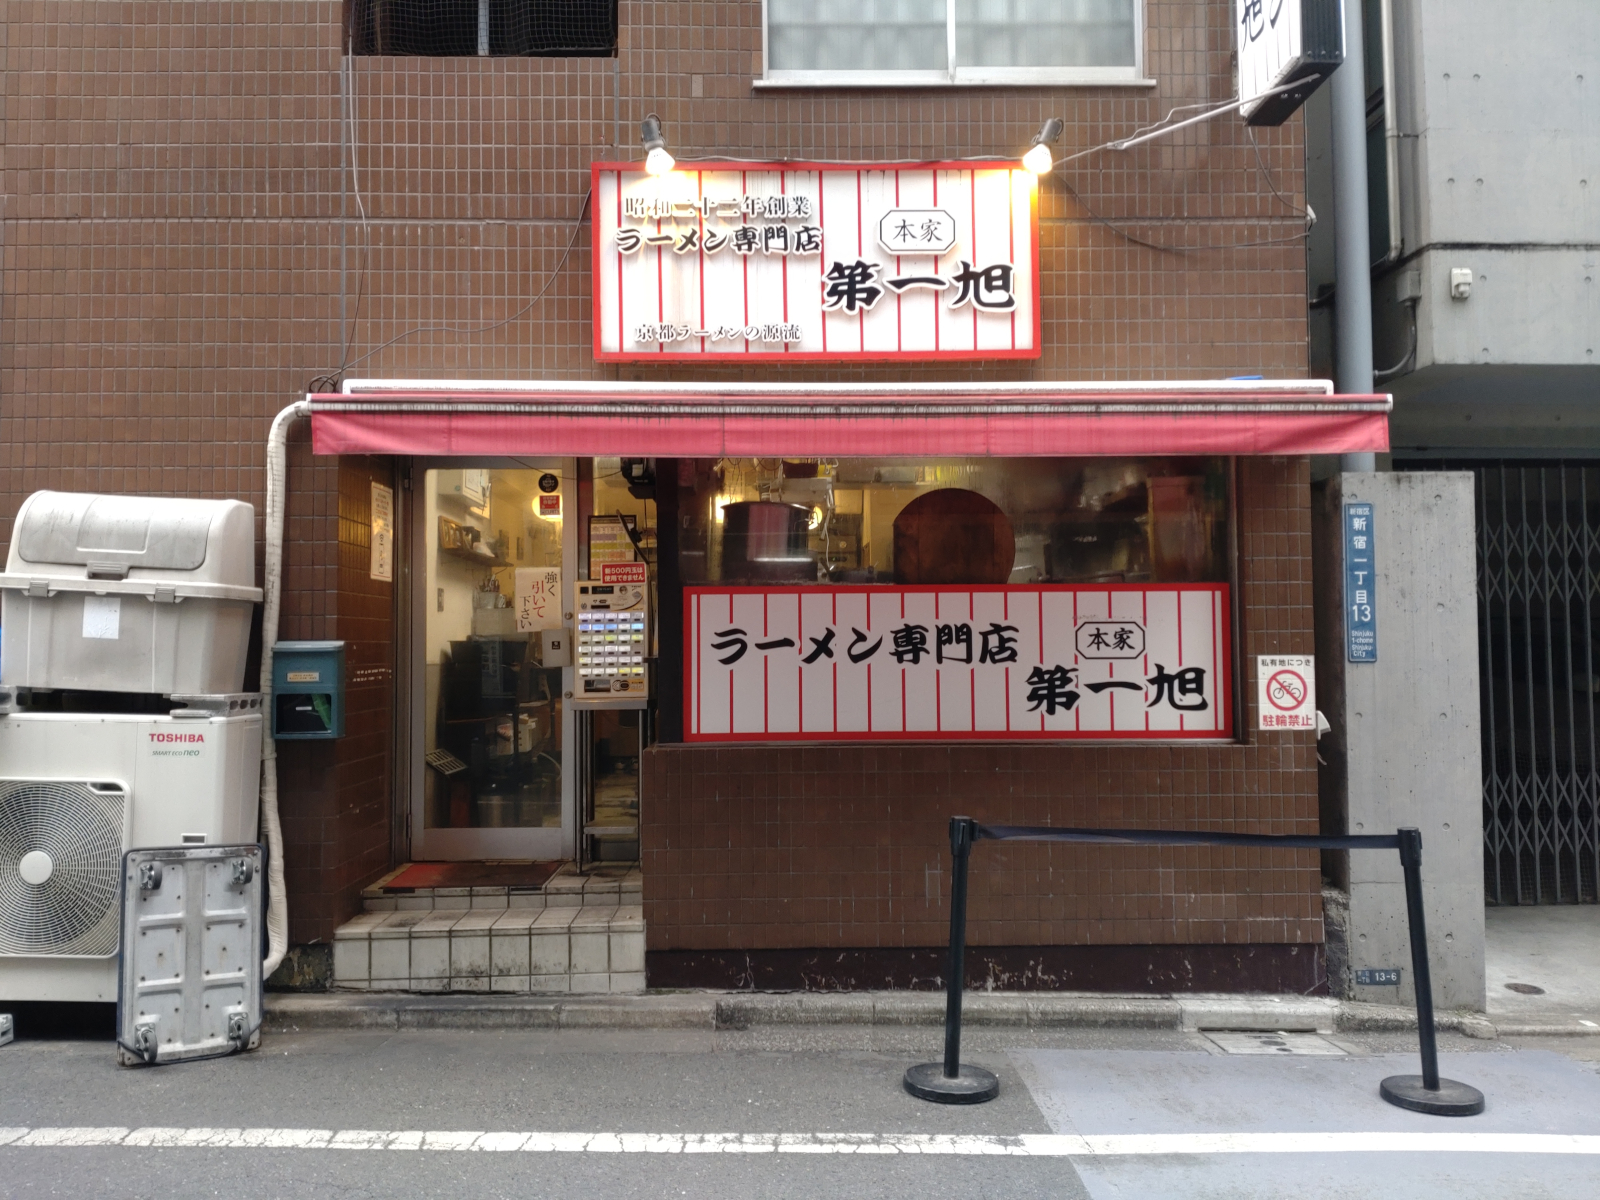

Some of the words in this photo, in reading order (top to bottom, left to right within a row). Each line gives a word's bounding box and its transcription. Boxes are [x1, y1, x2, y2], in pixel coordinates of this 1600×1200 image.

[625, 196, 812, 217] 昭和二十二年創業
[616, 225, 822, 254] ラーメン専門店
[893, 218, 944, 243] 本家
[825, 260, 1016, 312] 第一旭
[636, 323, 801, 341] 京都ラーメンの源流
[604, 567, 643, 575] 新500円玉は
[604, 574, 645, 582] 使用できません
[544, 571, 558, 597] 強く
[532, 580, 546, 618] 引いて
[519, 595, 532, 629] 下さい
[710, 623, 1019, 666] ラーメン専門店
[1086, 626, 1136, 652] 本家
[1261, 658, 1312, 667] 私有地につき
[1025, 664, 1210, 716] 第一旭
[1262, 714, 1313, 727] 駐輪禁止
[148, 733, 205, 743] TOSHIBA
[183, 749, 200, 757] neo
[1375, 972, 1397, 982] 13-6
